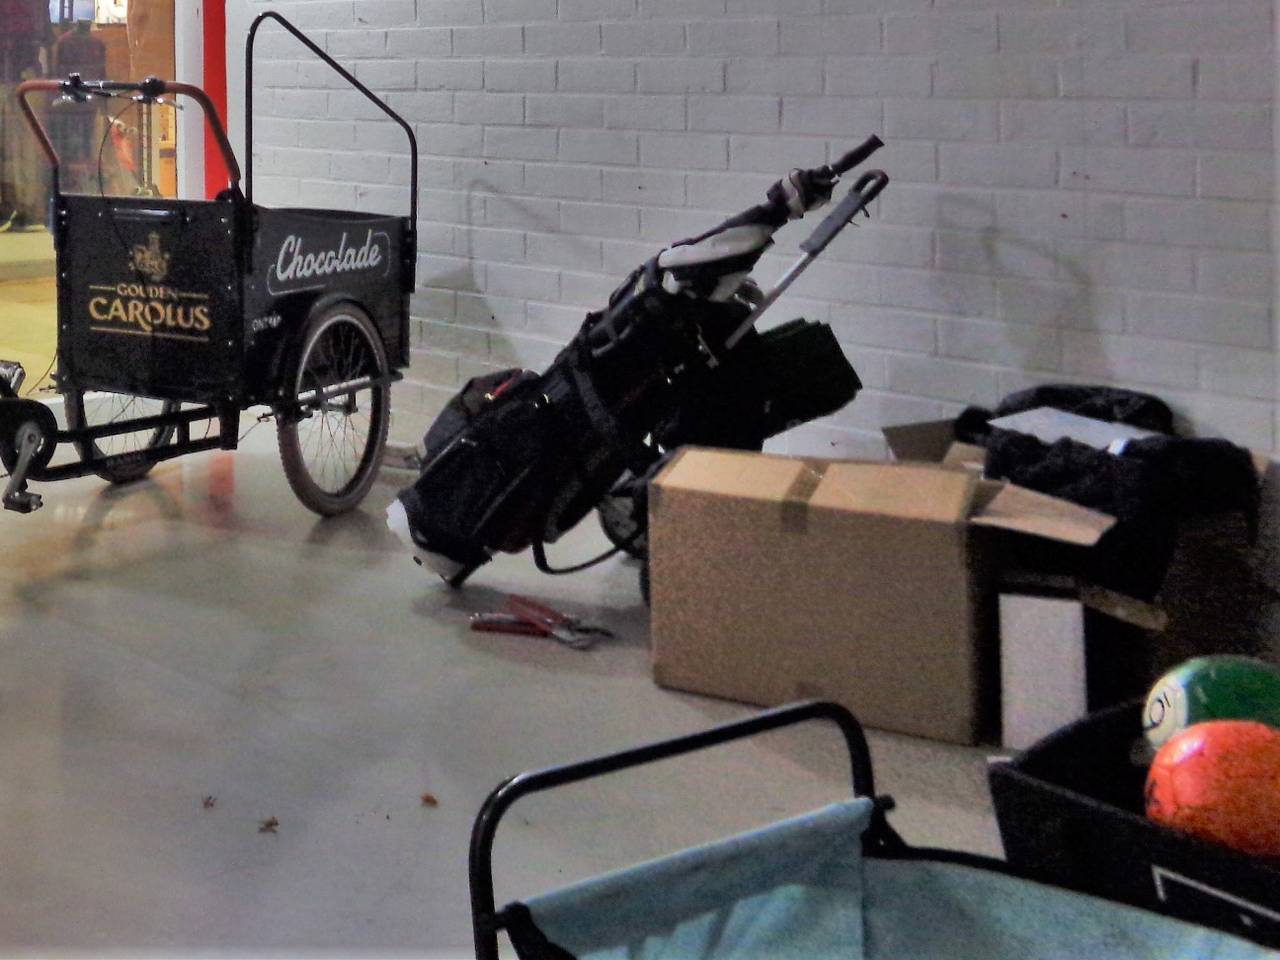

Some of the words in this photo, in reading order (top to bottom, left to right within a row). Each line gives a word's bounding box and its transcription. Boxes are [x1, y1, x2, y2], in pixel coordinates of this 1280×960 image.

[276, 229, 381, 281] Chocolade
[117, 283, 178, 300] GOUDEN
[89, 297, 211, 331] CAROLUS
